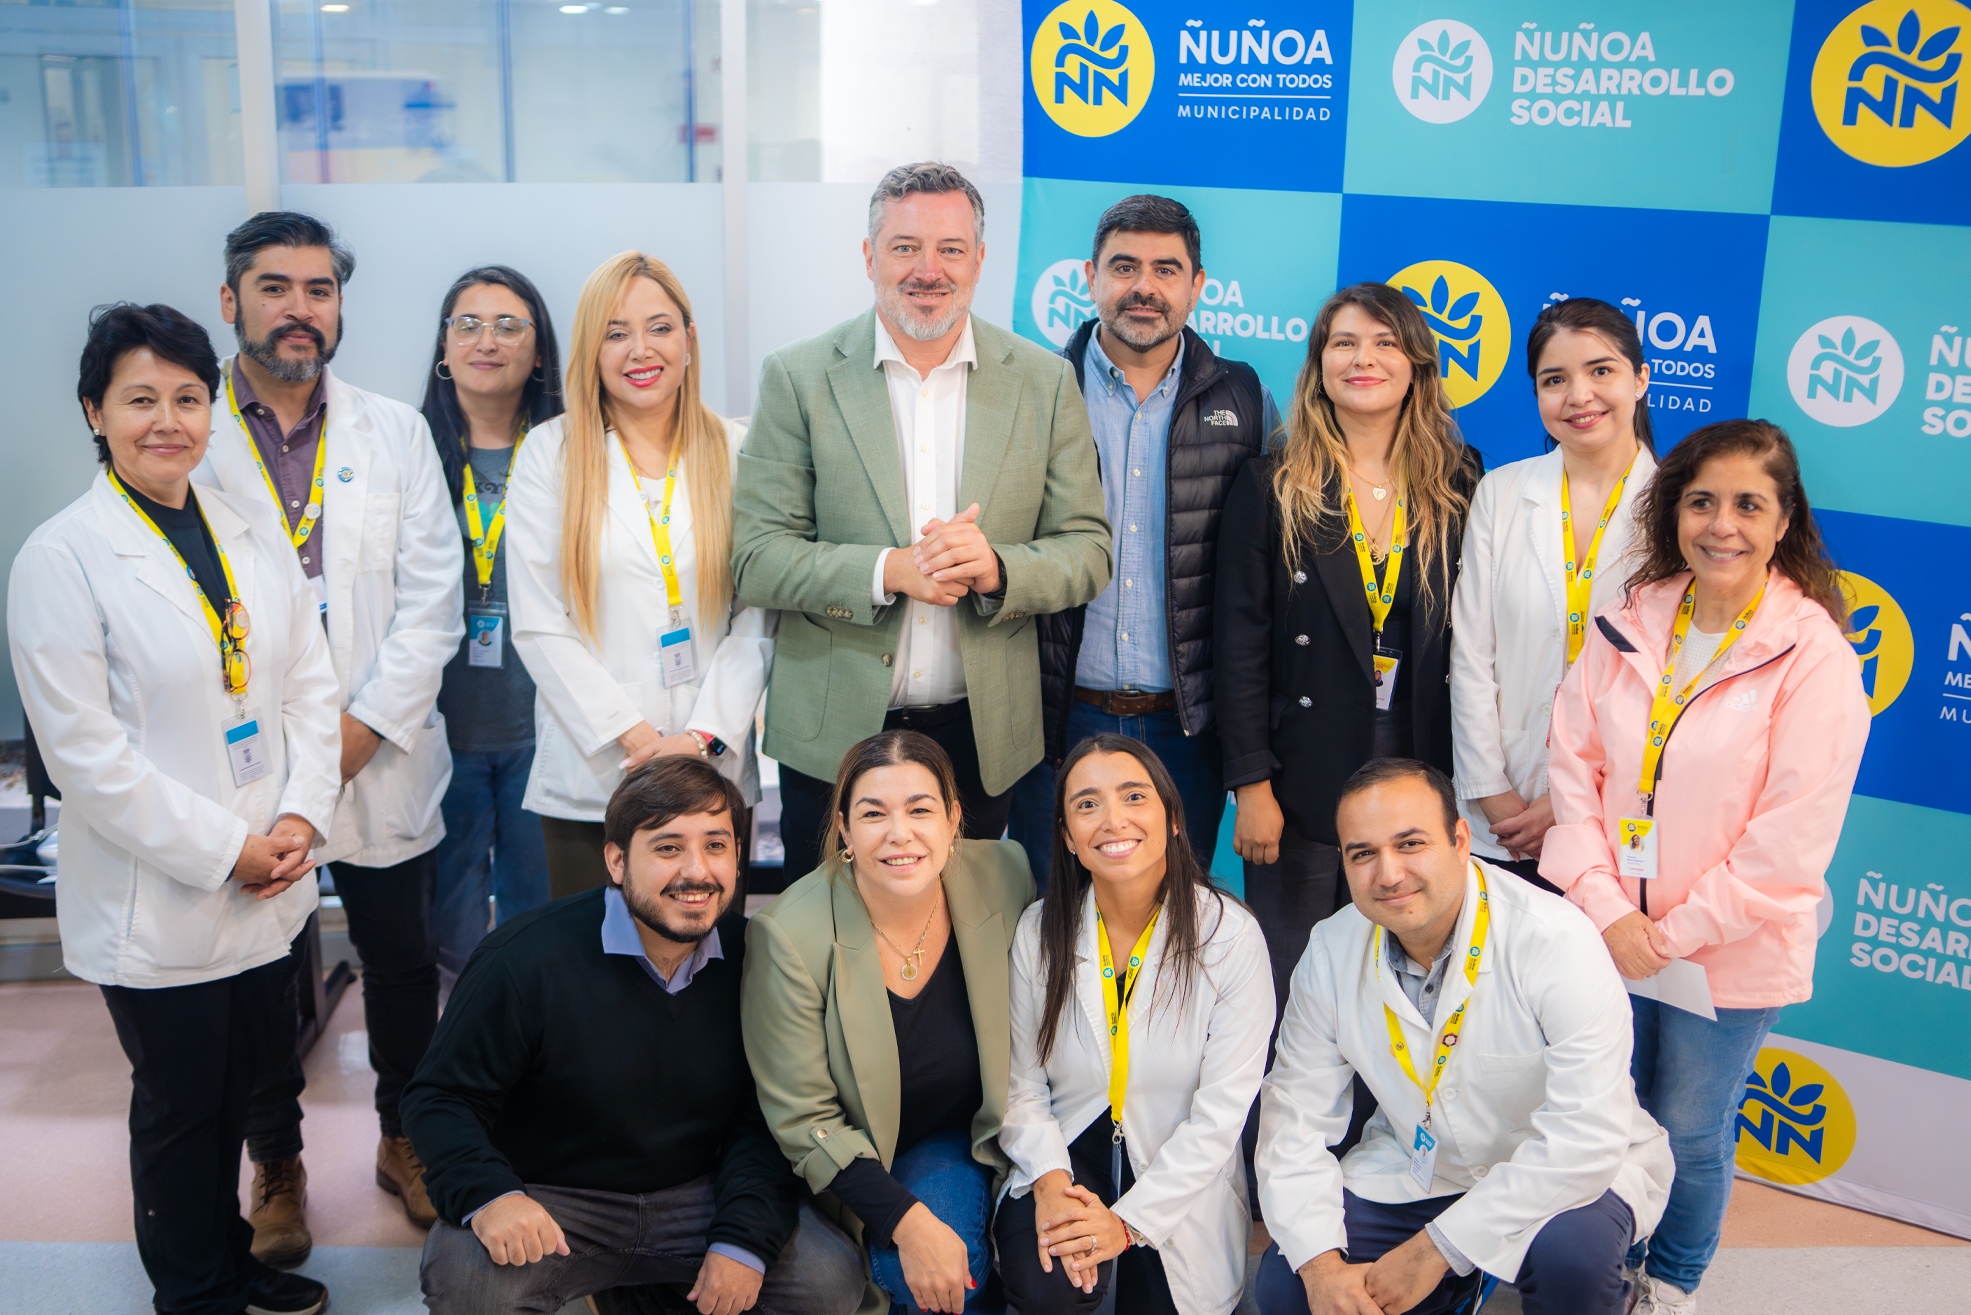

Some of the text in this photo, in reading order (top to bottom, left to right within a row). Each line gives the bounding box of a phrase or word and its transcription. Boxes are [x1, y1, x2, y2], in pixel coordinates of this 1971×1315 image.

[1179, 18, 1333, 65] ÑUÑOA
[1514, 21, 1656, 62] ÑUÑOA
[1179, 73, 1332, 89] MEJOR CON TODOS
[1512, 66, 1735, 97] DESARROLLO
[1177, 104, 1331, 121] MUNICIPALIDAD
[1509, 98, 1632, 128] SOCIAL
[1651, 358, 1716, 379] TODOS
[1853, 911, 1971, 960] DESAR
